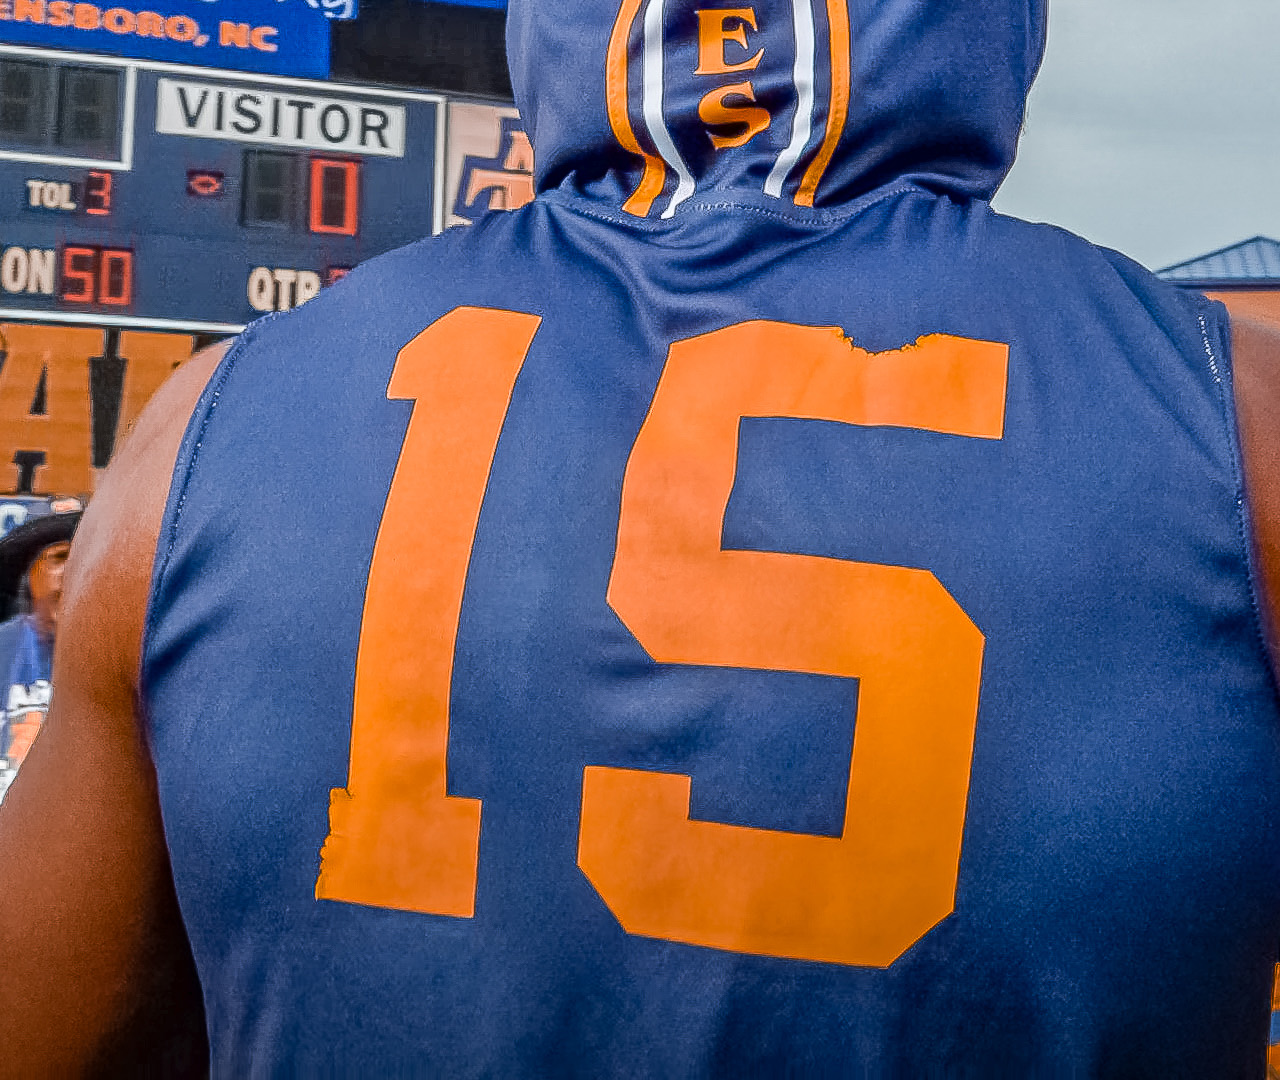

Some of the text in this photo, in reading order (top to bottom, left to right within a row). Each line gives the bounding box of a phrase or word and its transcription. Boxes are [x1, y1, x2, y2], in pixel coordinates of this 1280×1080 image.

[219, 20, 278, 53] NC
[177, 86, 392, 149] VISITOR
[27, 171, 112, 216] TOL 3
[0, 246, 56, 295] ON
[60, 244, 133, 307] 50
[315, 305, 1010, 969] 15
